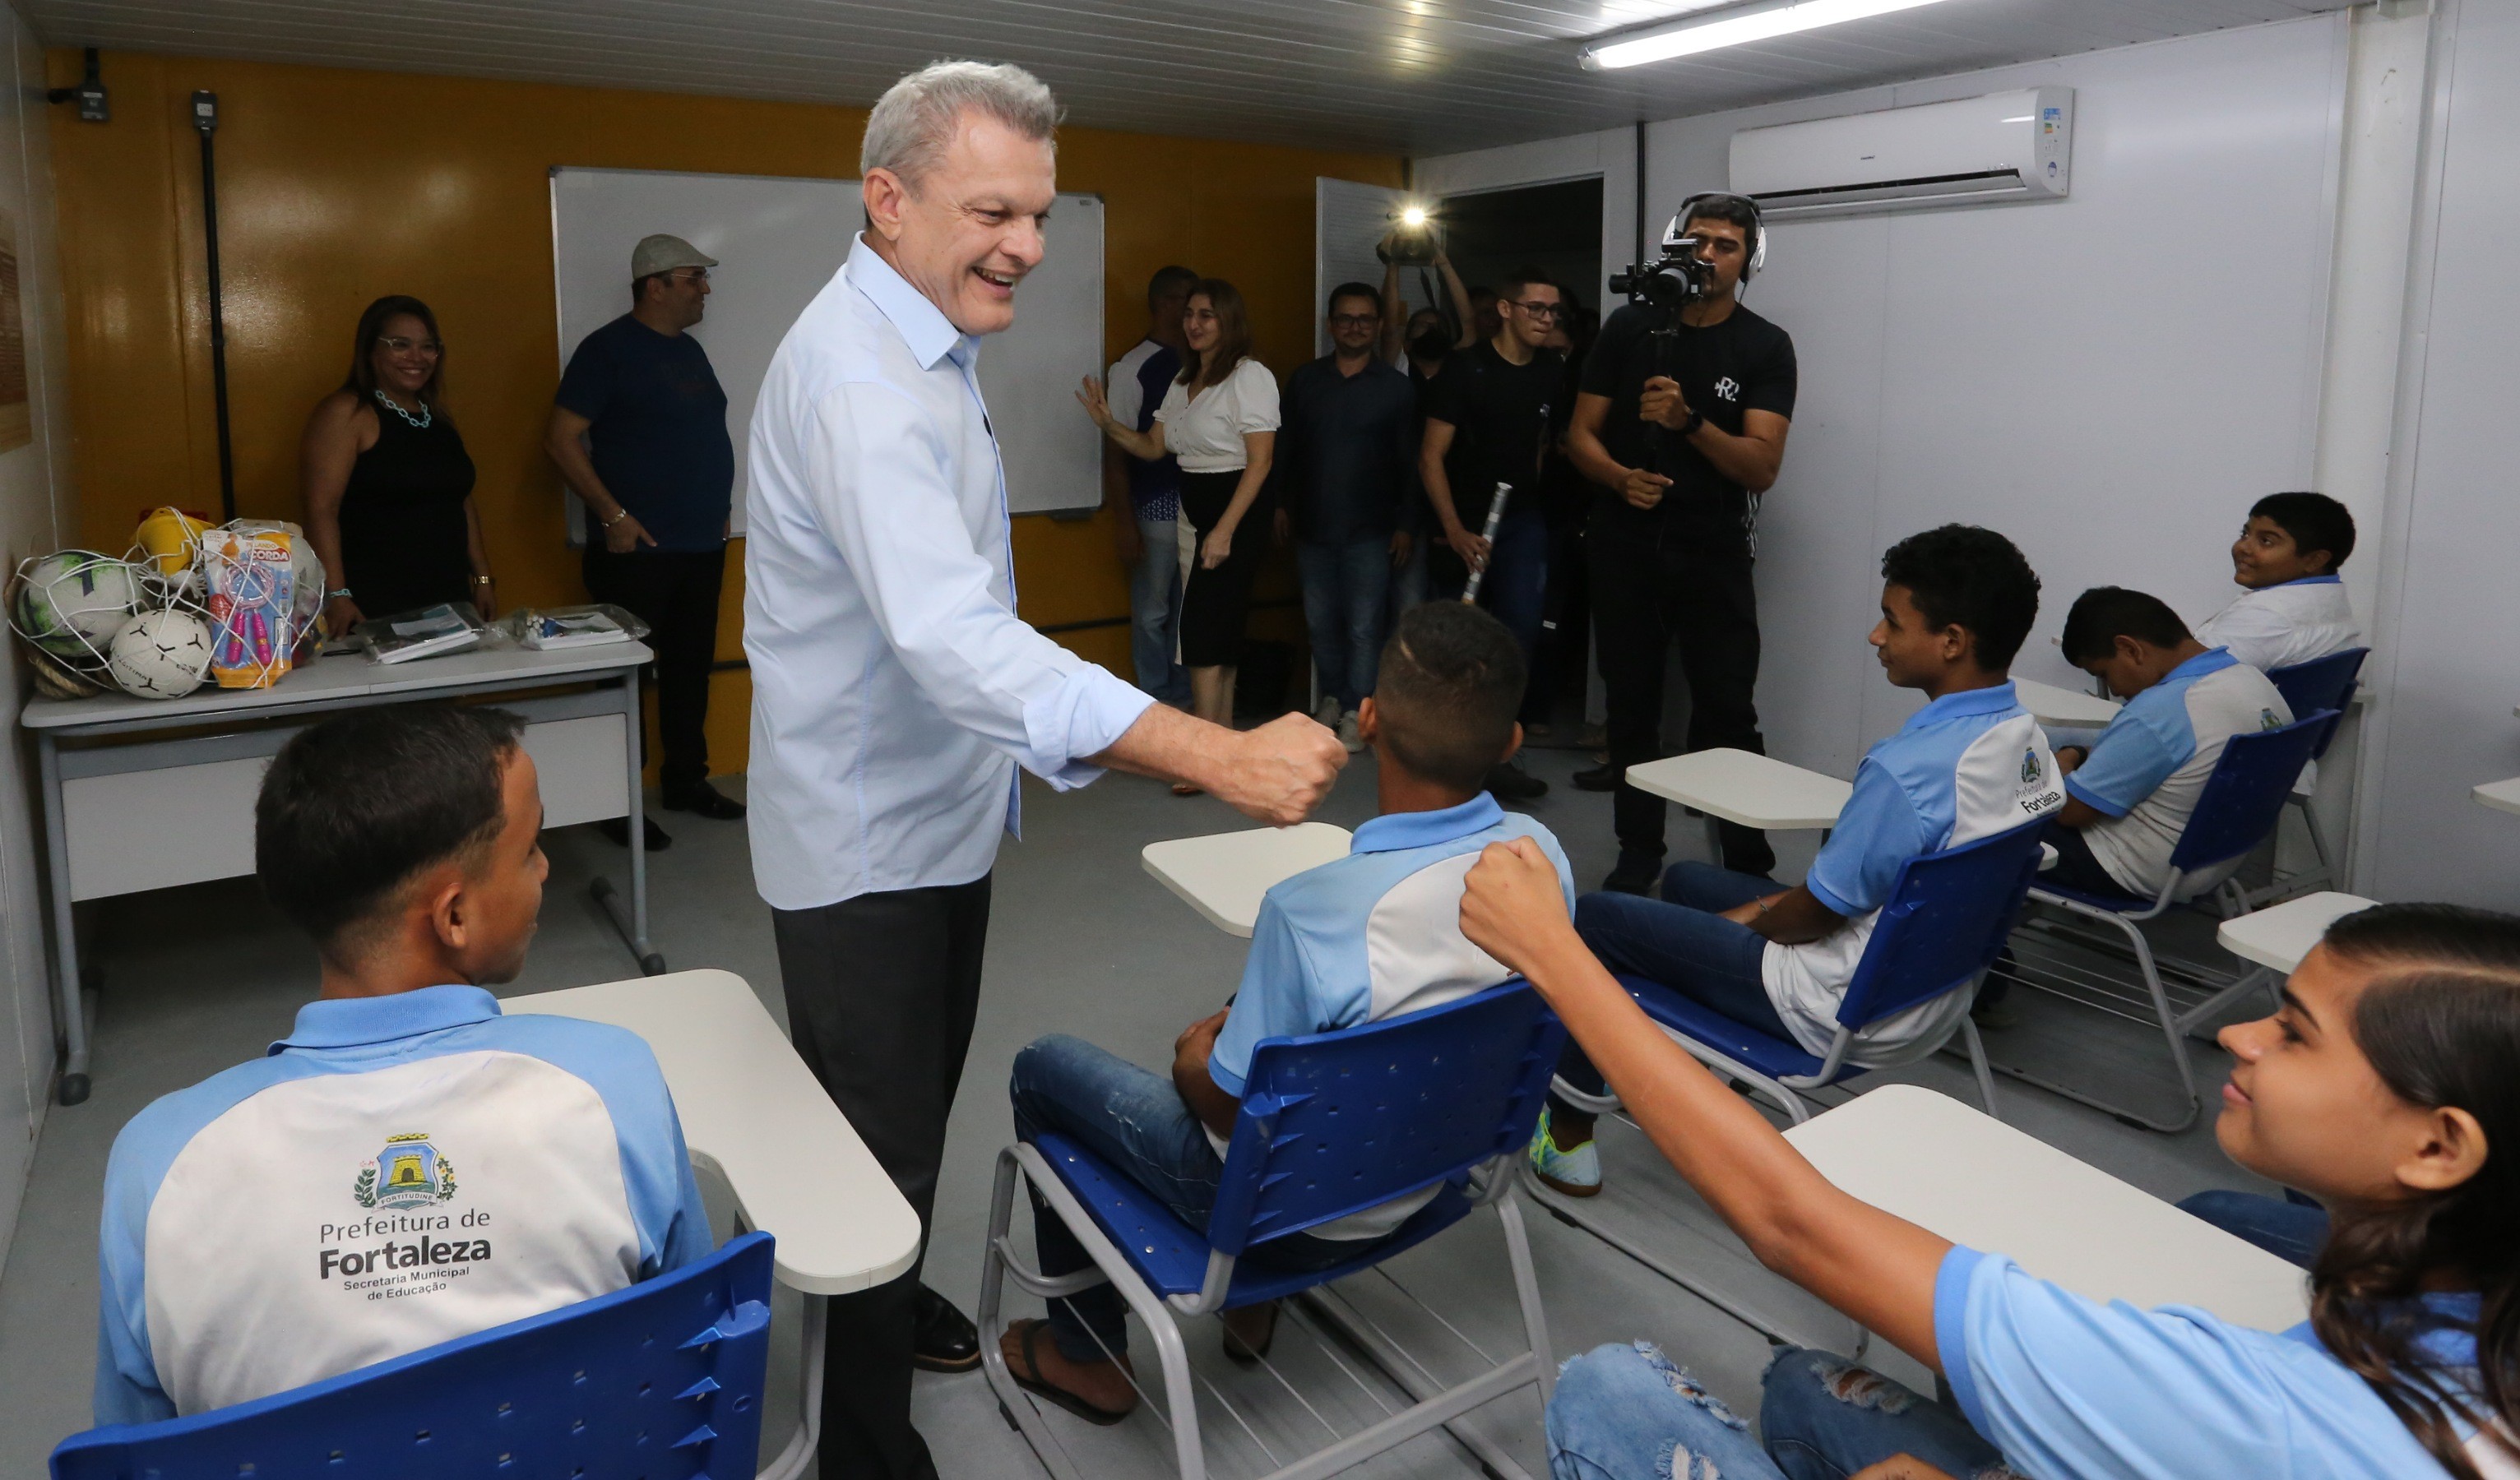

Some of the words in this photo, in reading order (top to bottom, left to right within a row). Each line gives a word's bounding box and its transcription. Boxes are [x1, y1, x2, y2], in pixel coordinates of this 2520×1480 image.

[245, 541, 276, 549] PLANDO
[248, 549, 290, 561] CORDA
[2015, 783, 2041, 798] Prefeitura
[2021, 791, 2061, 813] Fortaleza
[381, 1193, 433, 1205] FORTITUDINE
[320, 1215, 450, 1243] Prefeitura
[461, 1208, 490, 1228] de
[319, 1235, 491, 1279] Fortaleza
[344, 1274, 407, 1291] Secretaria
[410, 1267, 470, 1282] Municipal
[367, 1291, 383, 1301] de
[386, 1282, 447, 1299] Educação
